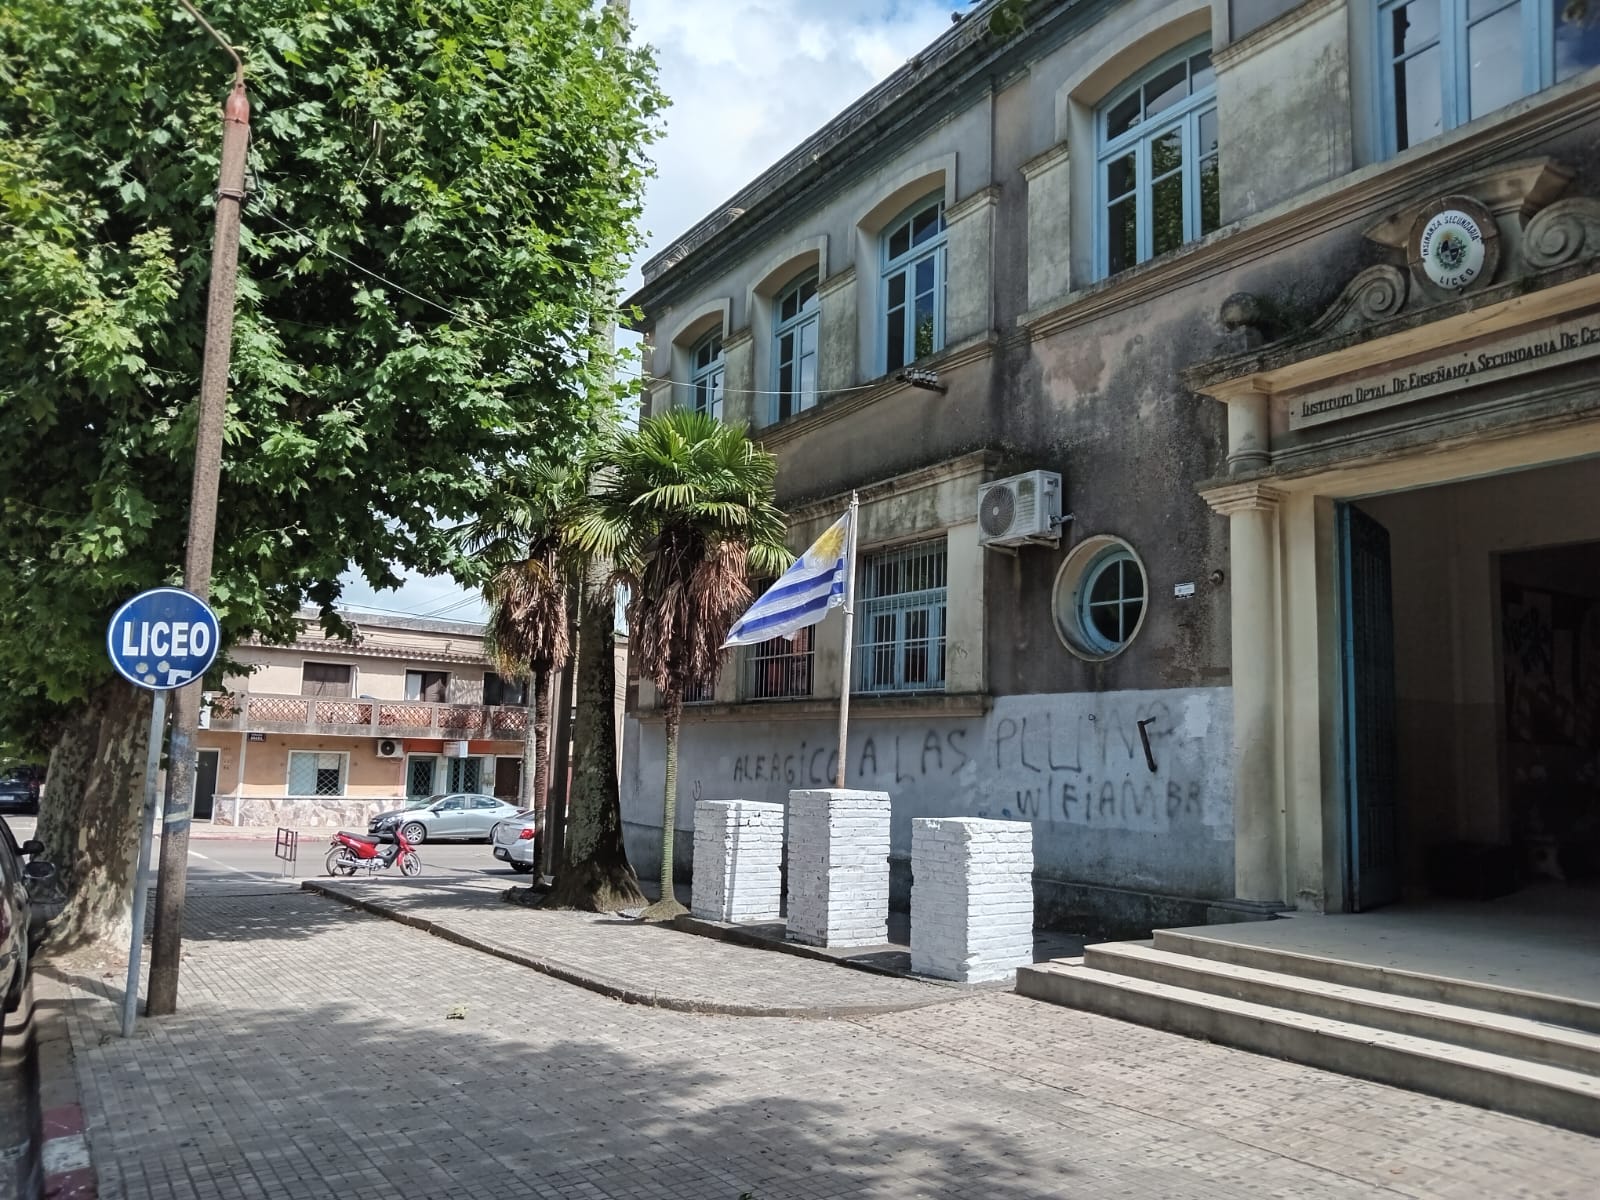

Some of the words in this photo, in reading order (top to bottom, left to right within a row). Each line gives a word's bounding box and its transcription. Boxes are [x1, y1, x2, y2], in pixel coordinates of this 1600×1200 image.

[1439, 267, 1475, 286] LICEO
[122, 621, 210, 657] LICEO
[858, 736, 877, 777] A
[894, 727, 968, 783] LAS
